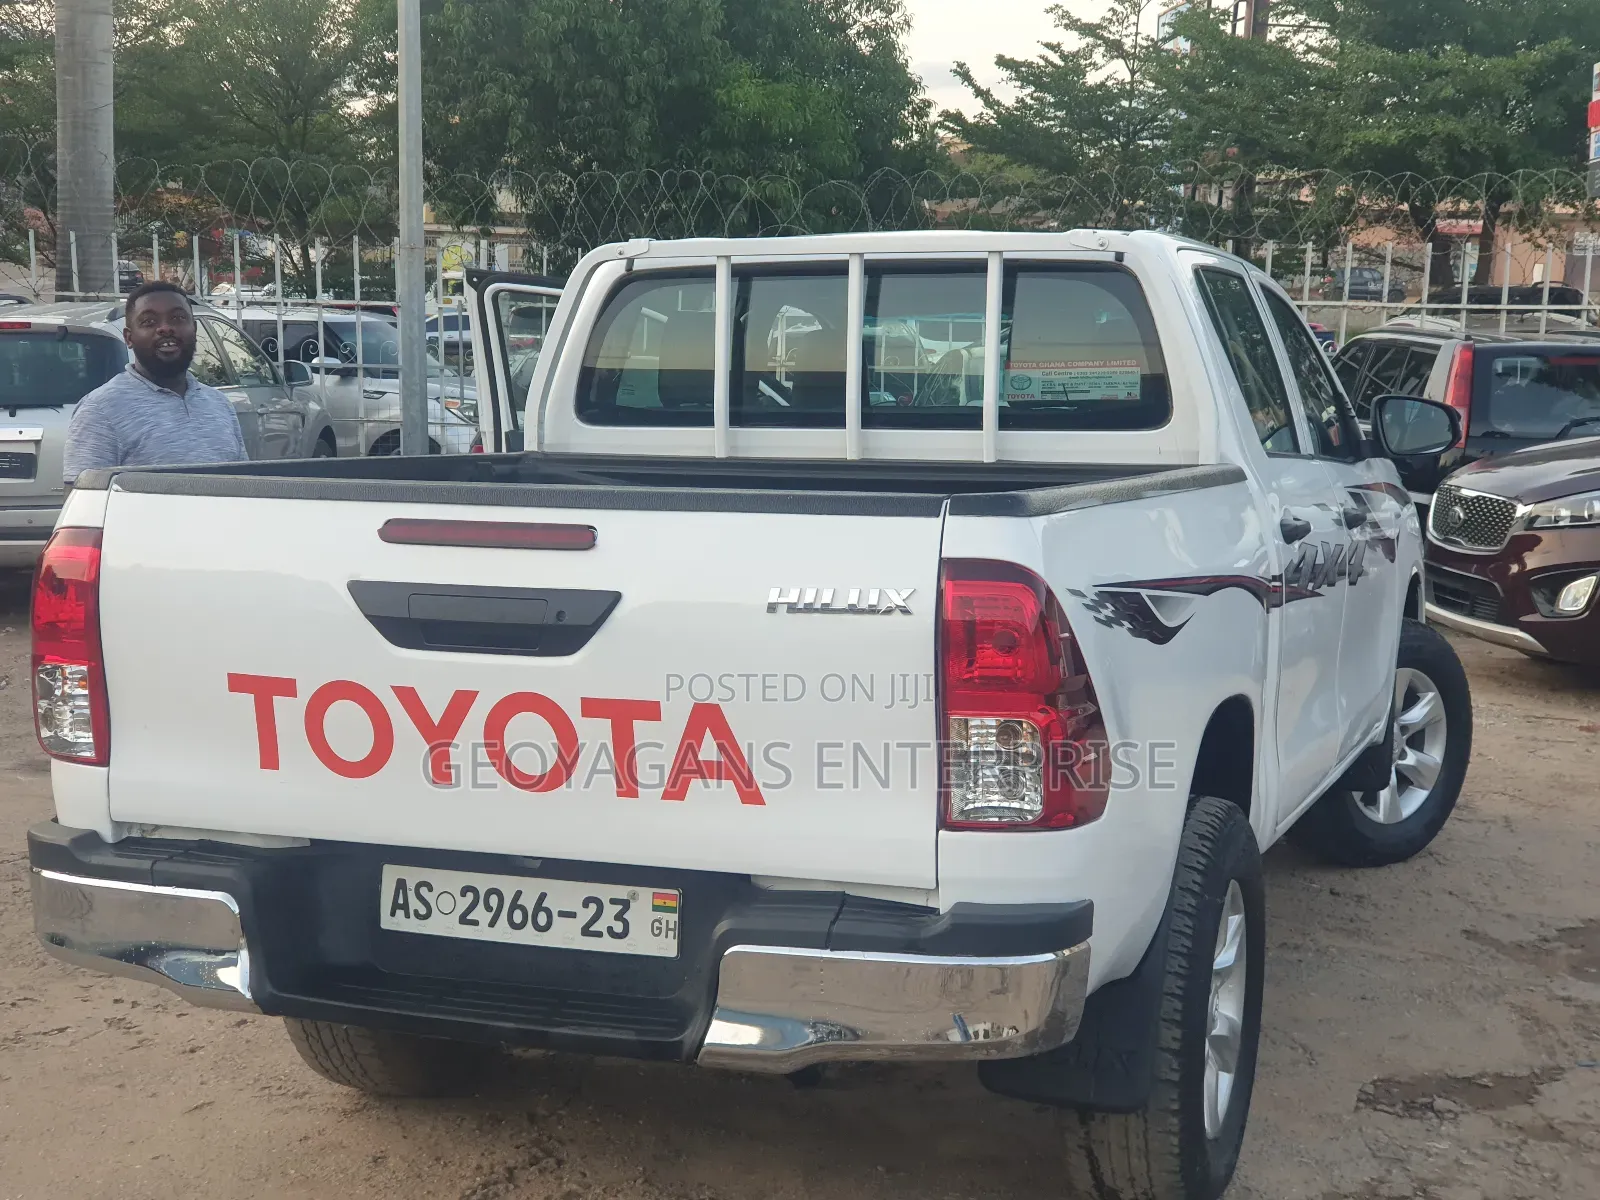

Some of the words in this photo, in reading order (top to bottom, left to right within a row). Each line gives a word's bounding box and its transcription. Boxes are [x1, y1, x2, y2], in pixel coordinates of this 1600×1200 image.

[1282, 540, 1368, 592] 4X4
[765, 587, 916, 616] HILUX
[227, 672, 767, 807] TOYOTA
[389, 877, 434, 921] AS
[458, 884, 631, 940] 2966-23
[650, 917, 677, 940] GH
